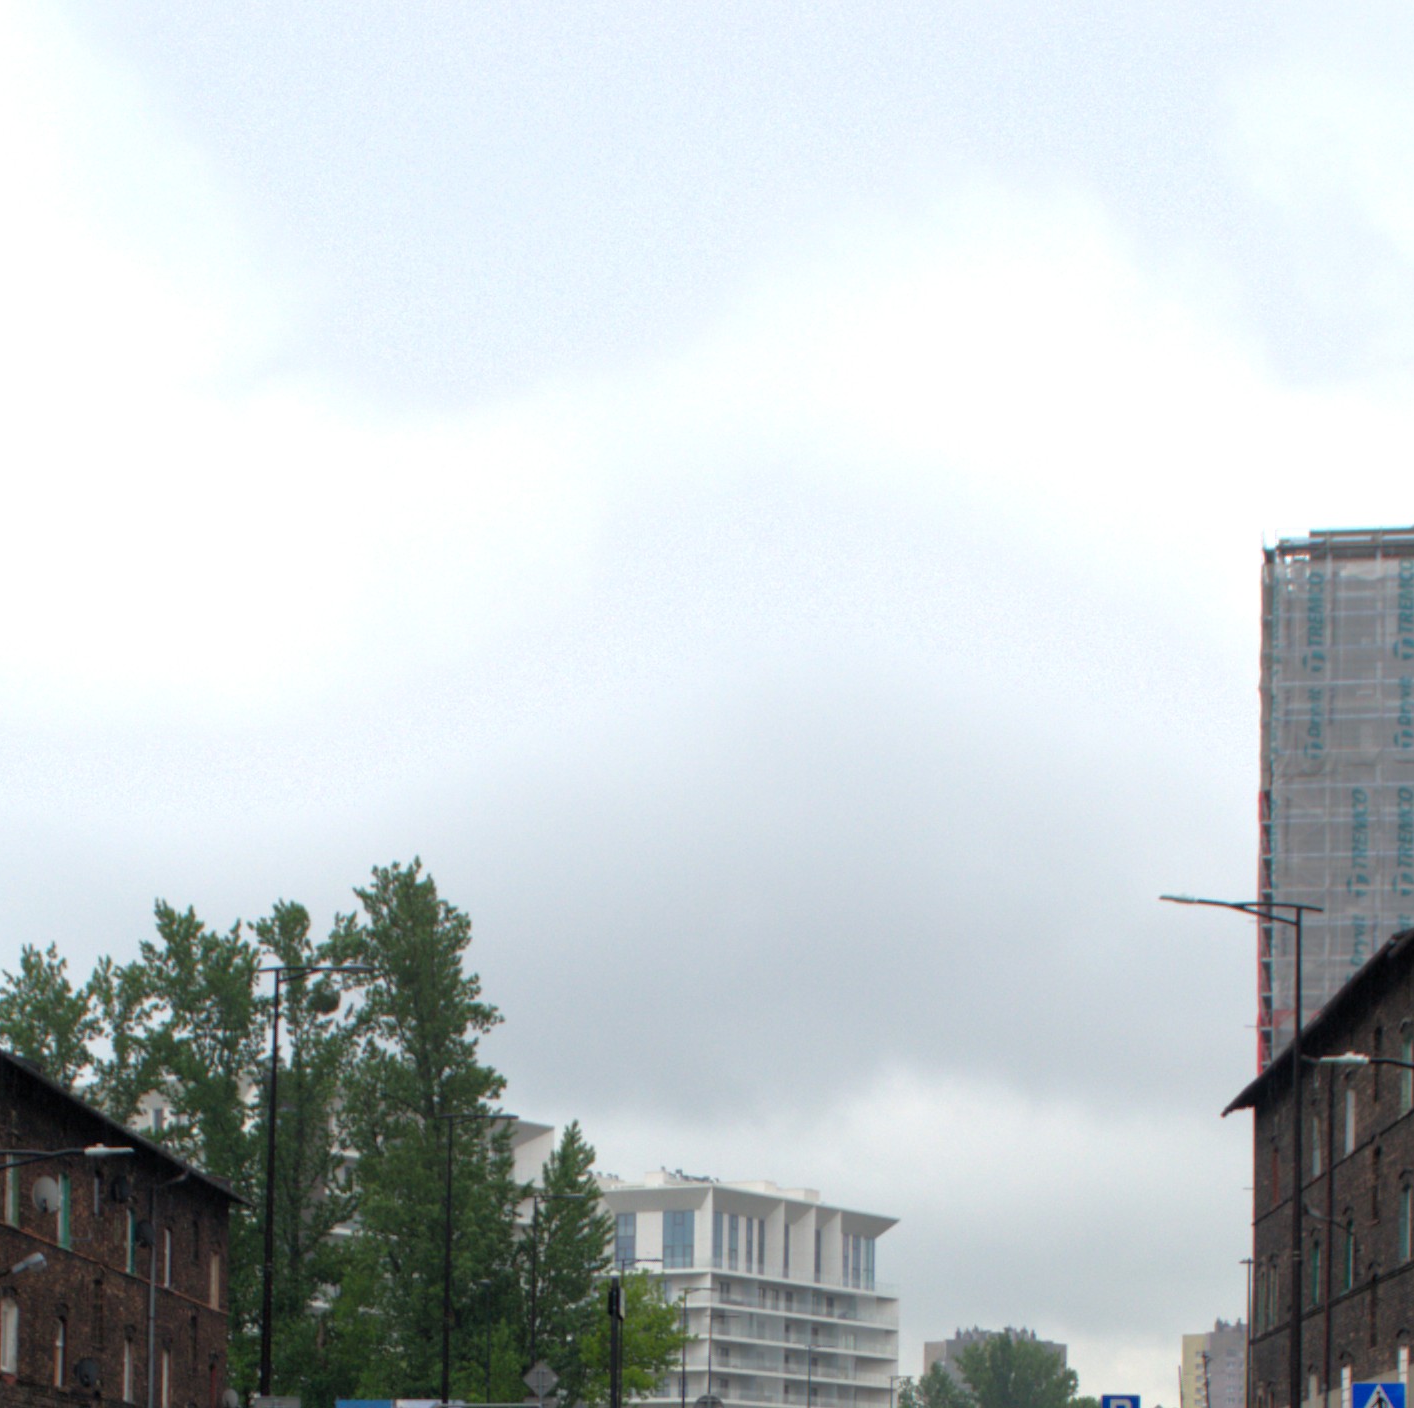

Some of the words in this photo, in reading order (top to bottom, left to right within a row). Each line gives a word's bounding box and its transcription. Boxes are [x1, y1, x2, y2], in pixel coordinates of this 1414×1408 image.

[1307, 572, 1324, 647] TREMCO
[1398, 558, 1414, 634] TREMCO
[1351, 788, 1368, 869] TREMCO
[1397, 787, 1414, 868] TREMCO
